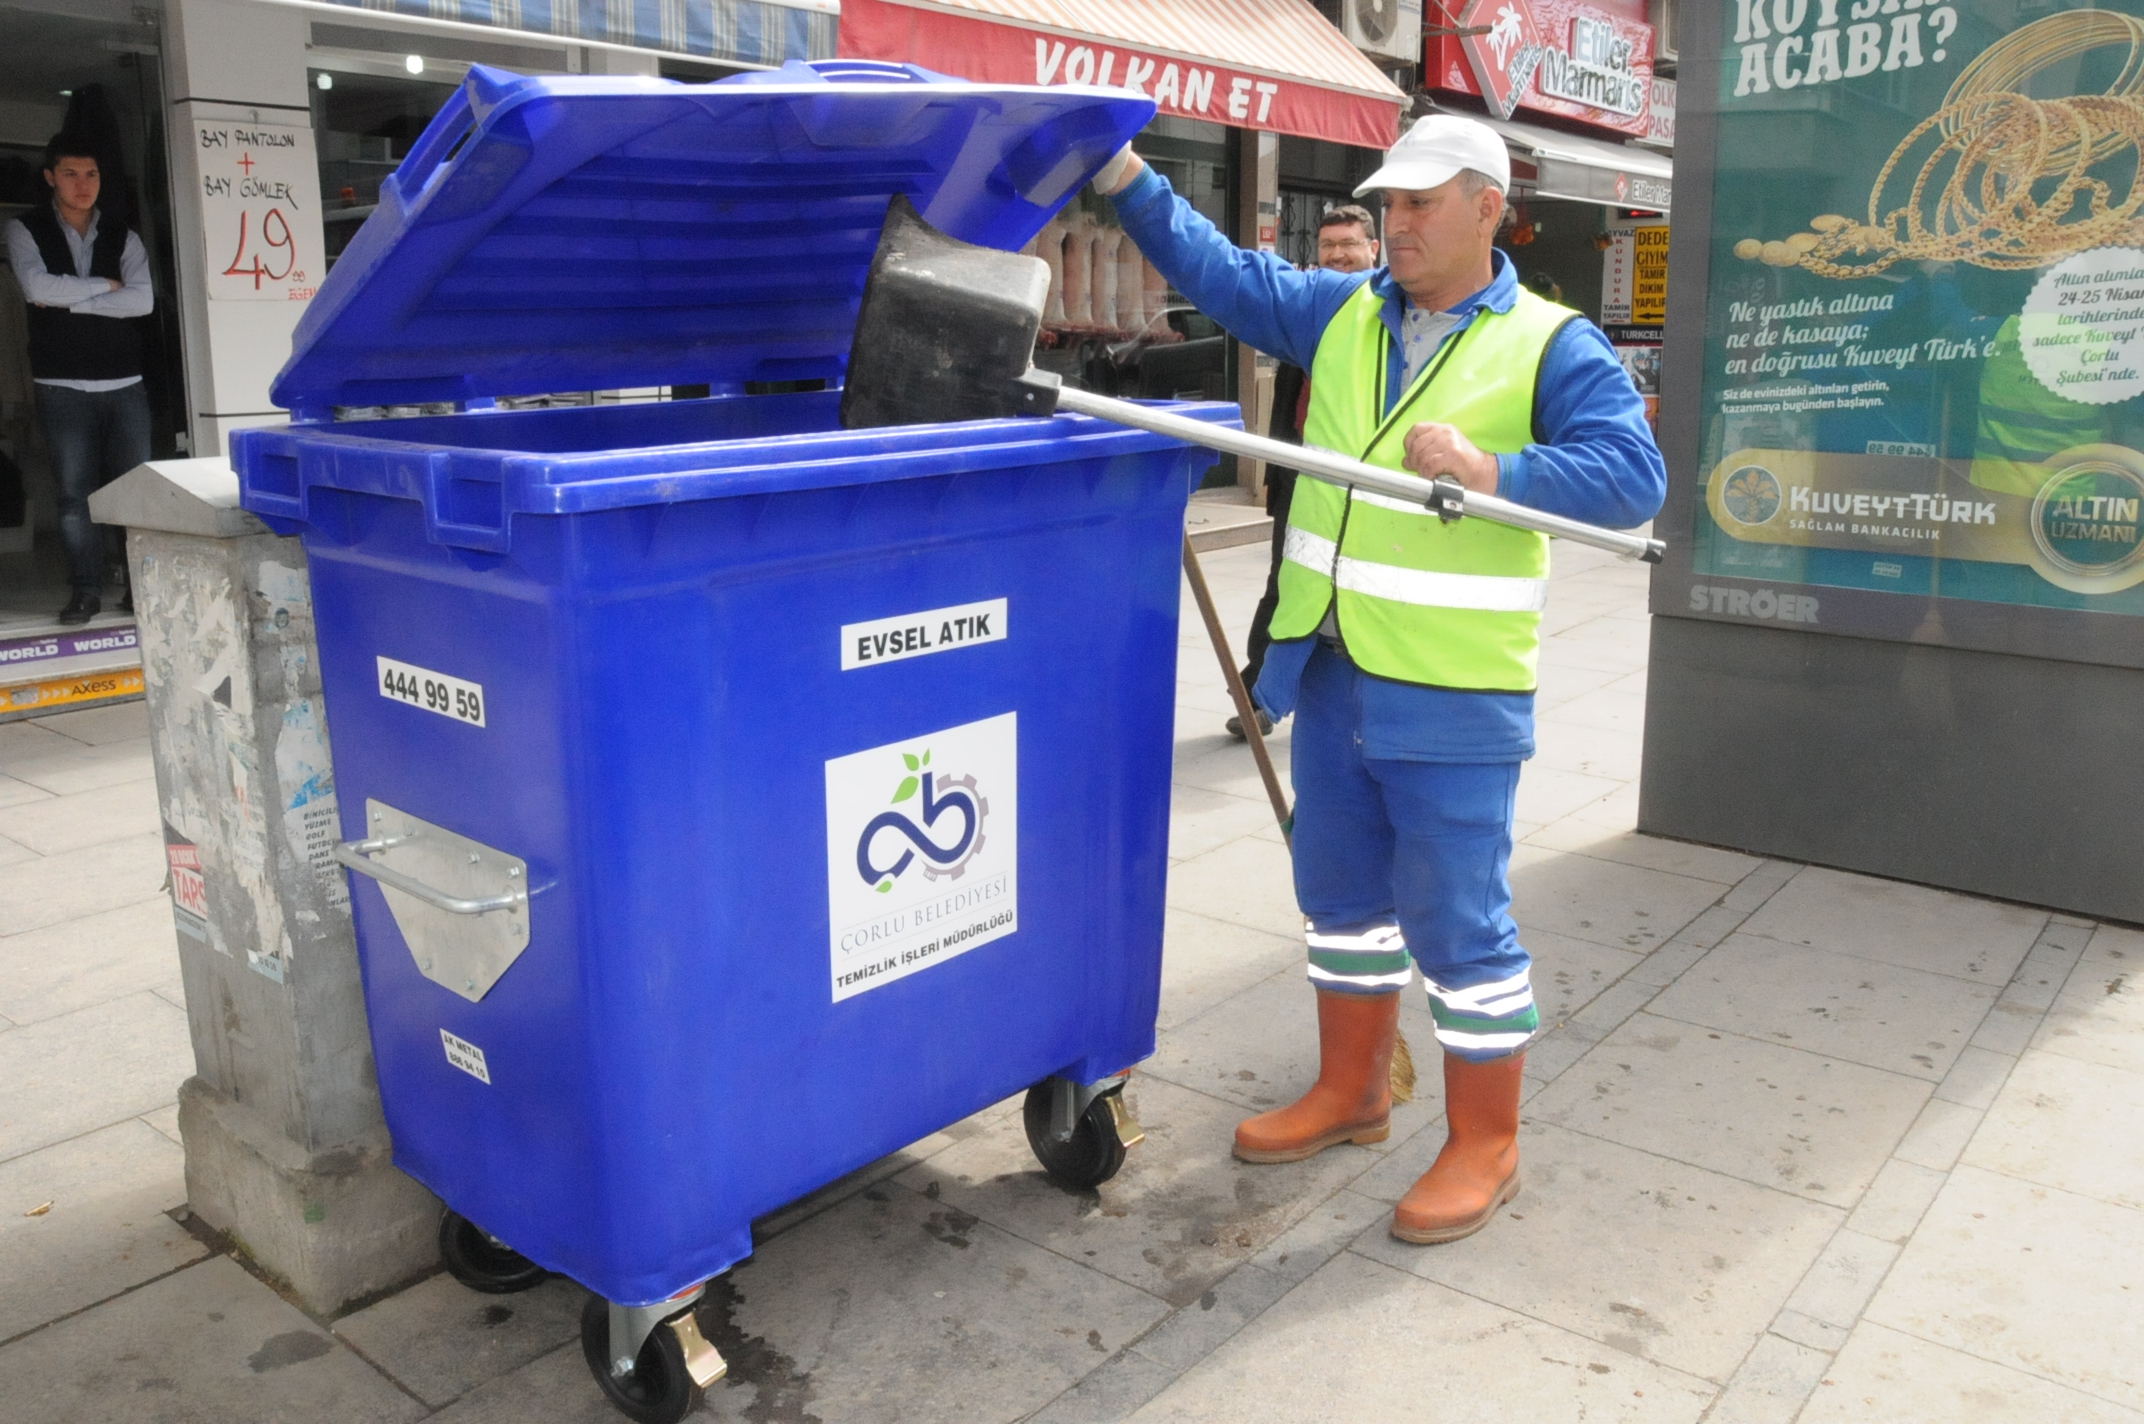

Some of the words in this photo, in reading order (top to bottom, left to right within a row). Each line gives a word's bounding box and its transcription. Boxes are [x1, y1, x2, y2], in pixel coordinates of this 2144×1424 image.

[1577, 19, 1632, 73] Etiler
[1733, 6, 1958, 97] ACABA?
[1035, 37, 1216, 114] VOLKAN
[1228, 76, 1278, 123] ET
[1545, 48, 1643, 113] Marmaris
[200, 129, 228, 148] BAY
[235, 129, 295, 148] PANTOLON
[204, 175, 231, 198] BAY
[239, 176, 299, 211] GÖMLEK
[222, 207, 297, 291] 49
[1637, 231, 1669, 246] DEDE
[2054, 272, 2091, 288] Altın
[1729, 302, 1756, 323] Ne
[1759, 296, 1824, 326] yastık
[1828, 293, 1894, 314] altına
[2058, 289, 2102, 306] 24-25
[1726, 333, 1750, 349] ne
[1753, 327, 1778, 347] de
[1781, 324, 1869, 347] kasaya;
[2032, 331, 2082, 347] sadece
[2085, 327, 2137, 344] Kuveyt
[1724, 359, 1747, 374] en
[1751, 352, 1837, 377] doğrusu
[1843, 343, 1919, 370] Kuveyt
[2081, 349, 2119, 366] Çorlu
[1723, 389, 1739, 400] Siz
[1739, 388, 1753, 399] de
[1754, 384, 1807, 398] evinizdeki
[1808, 382, 1849, 396] altınları
[1851, 379, 1890, 395] getirin,
[1722, 403, 1781, 415] kazanmaya
[1782, 400, 1835, 413] bugünden
[1836, 396, 1885, 410] başlayın.
[2052, 494, 2139, 522] ALTIN
[1789, 518, 1846, 533] SAĞLAM
[1851, 523, 1941, 540] BANKACILIK
[2051, 521, 2137, 543] UZMANI
[1688, 584, 1820, 624] STRÖER
[73, 634, 137, 652] WORLD
[857, 624, 932, 662] EVSEL
[938, 612, 991, 646] ATIK
[384, 668, 420, 703] 444
[424, 679, 450, 712] 99
[456, 687, 481, 722] 59
[840, 915, 906, 955] ÇORLU
[914, 874, 1007, 927] BELEDİYESİ
[836, 956, 898, 989] TEMİZLİK
[901, 940, 940, 966] İŞLERİ
[943, 908, 1013, 949] MÜDÜRLÜĞÜ
